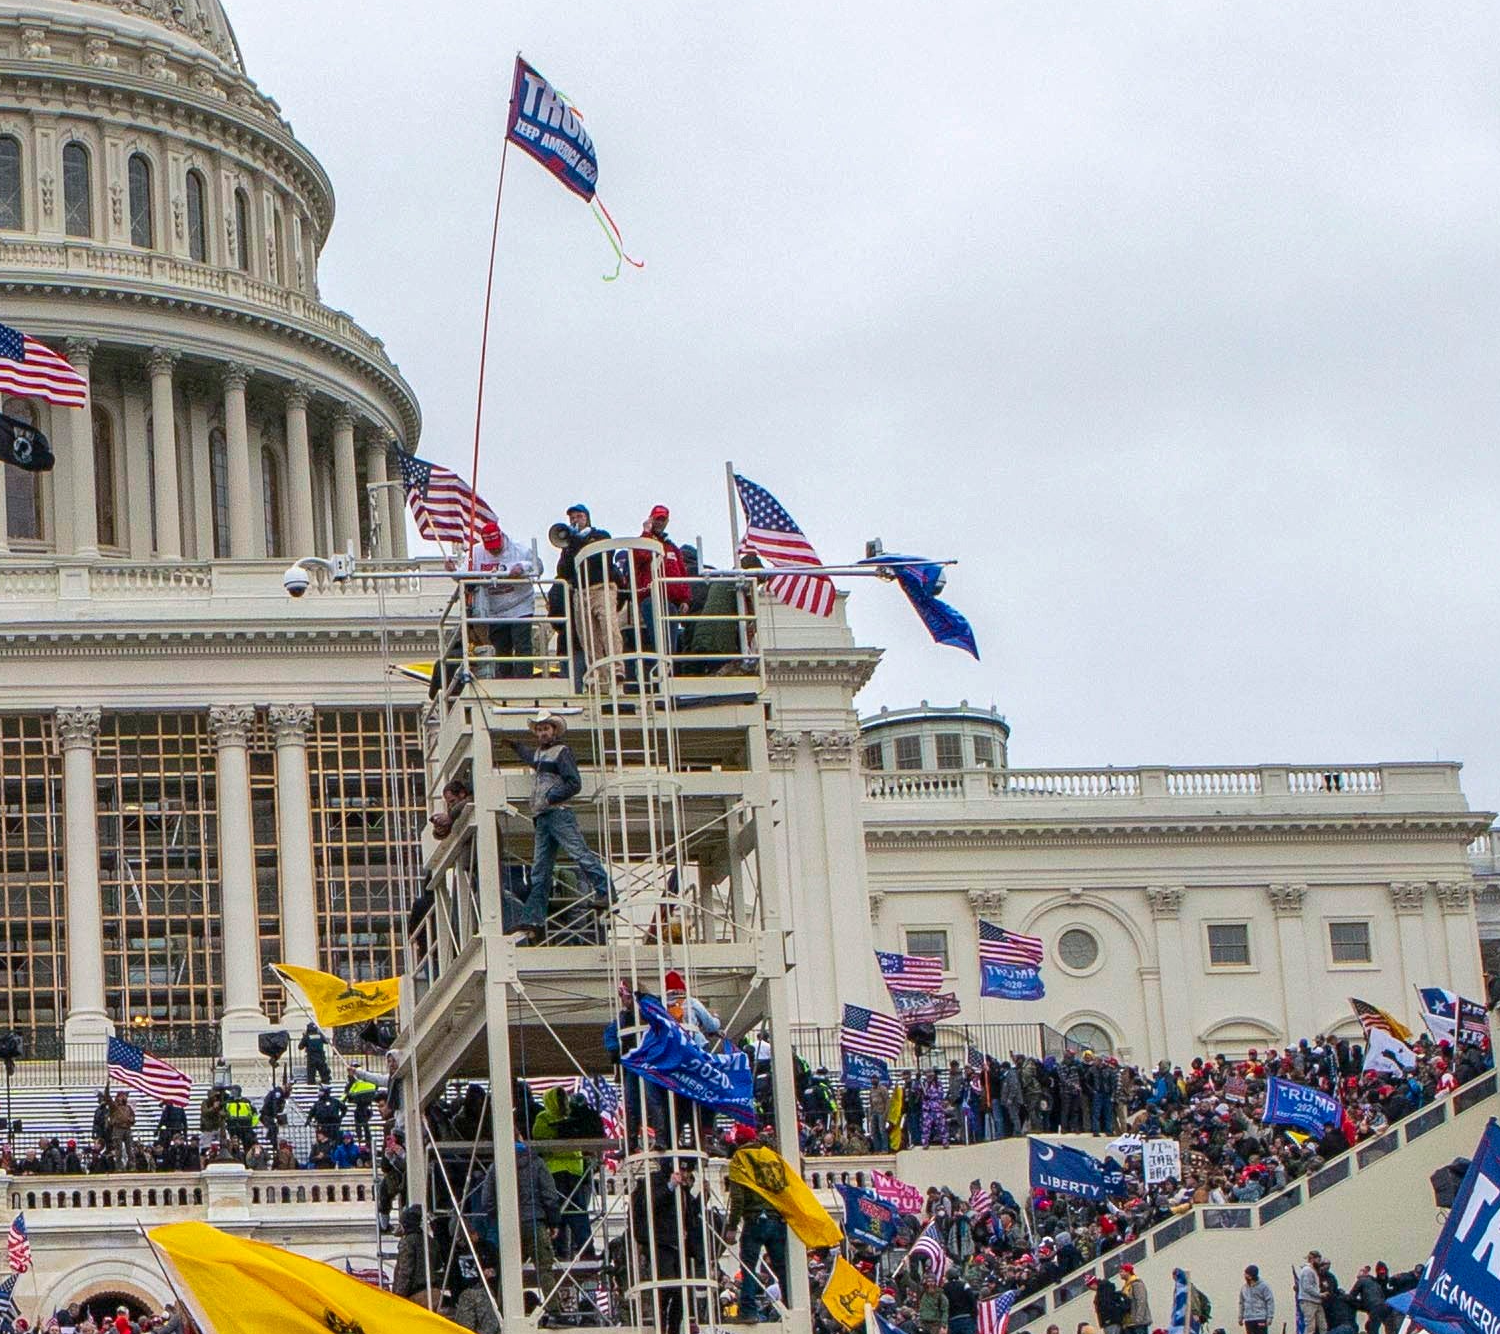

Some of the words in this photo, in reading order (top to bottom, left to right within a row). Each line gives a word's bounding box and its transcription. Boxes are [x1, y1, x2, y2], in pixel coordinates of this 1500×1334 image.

[540, 134, 581, 167] AMERICA
[1278, 1083, 1337, 1114] TRUMP
[1039, 1173, 1100, 1198] LIBERTY
